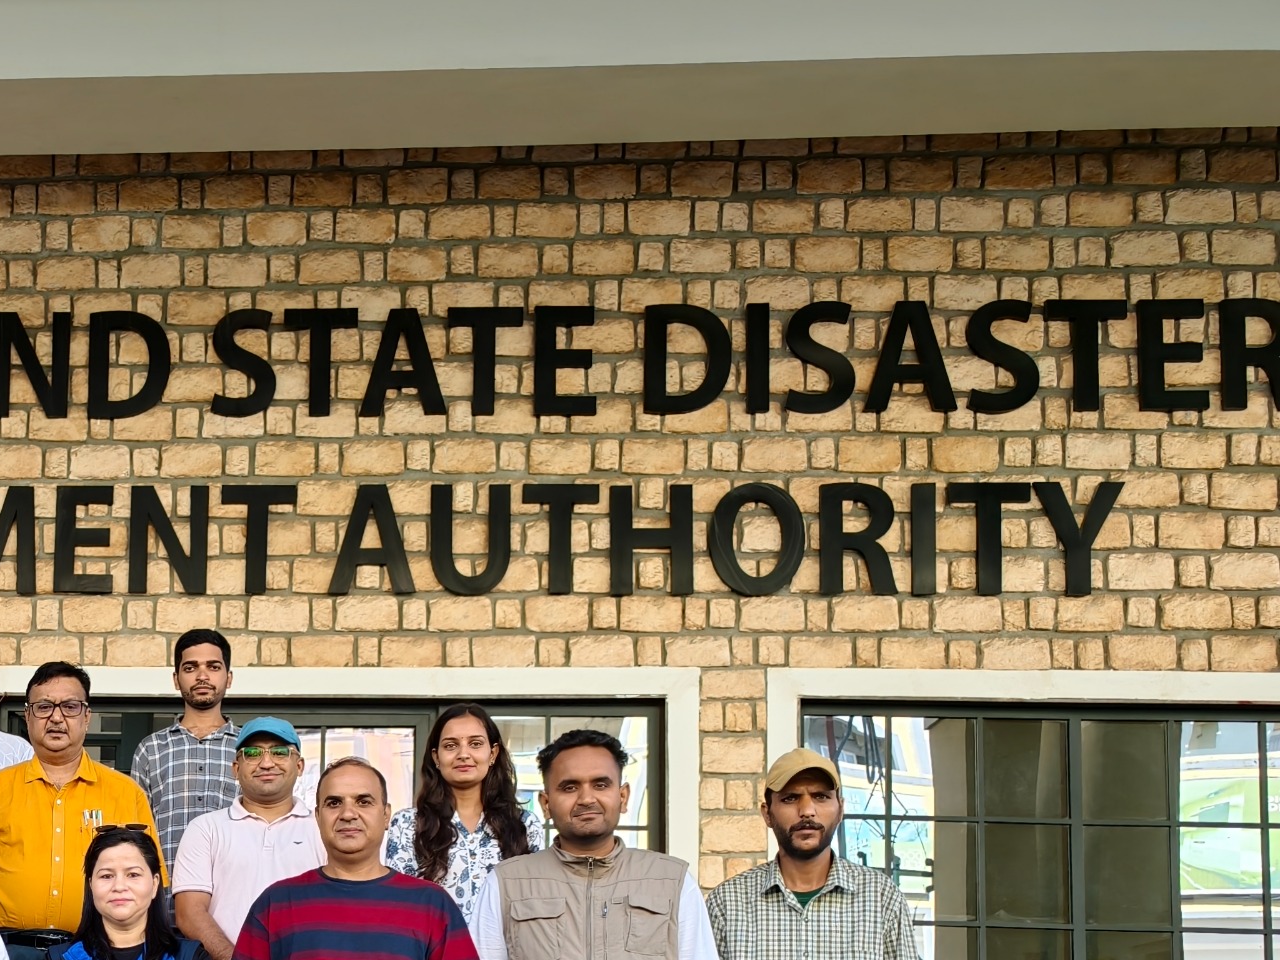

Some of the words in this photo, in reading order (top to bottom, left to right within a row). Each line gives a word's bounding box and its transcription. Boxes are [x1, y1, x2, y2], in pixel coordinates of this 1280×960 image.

[212, 305, 596, 417] STATE
[644, 297, 1280, 416] DISASTER
[328, 482, 1124, 597] AUTHORITY
